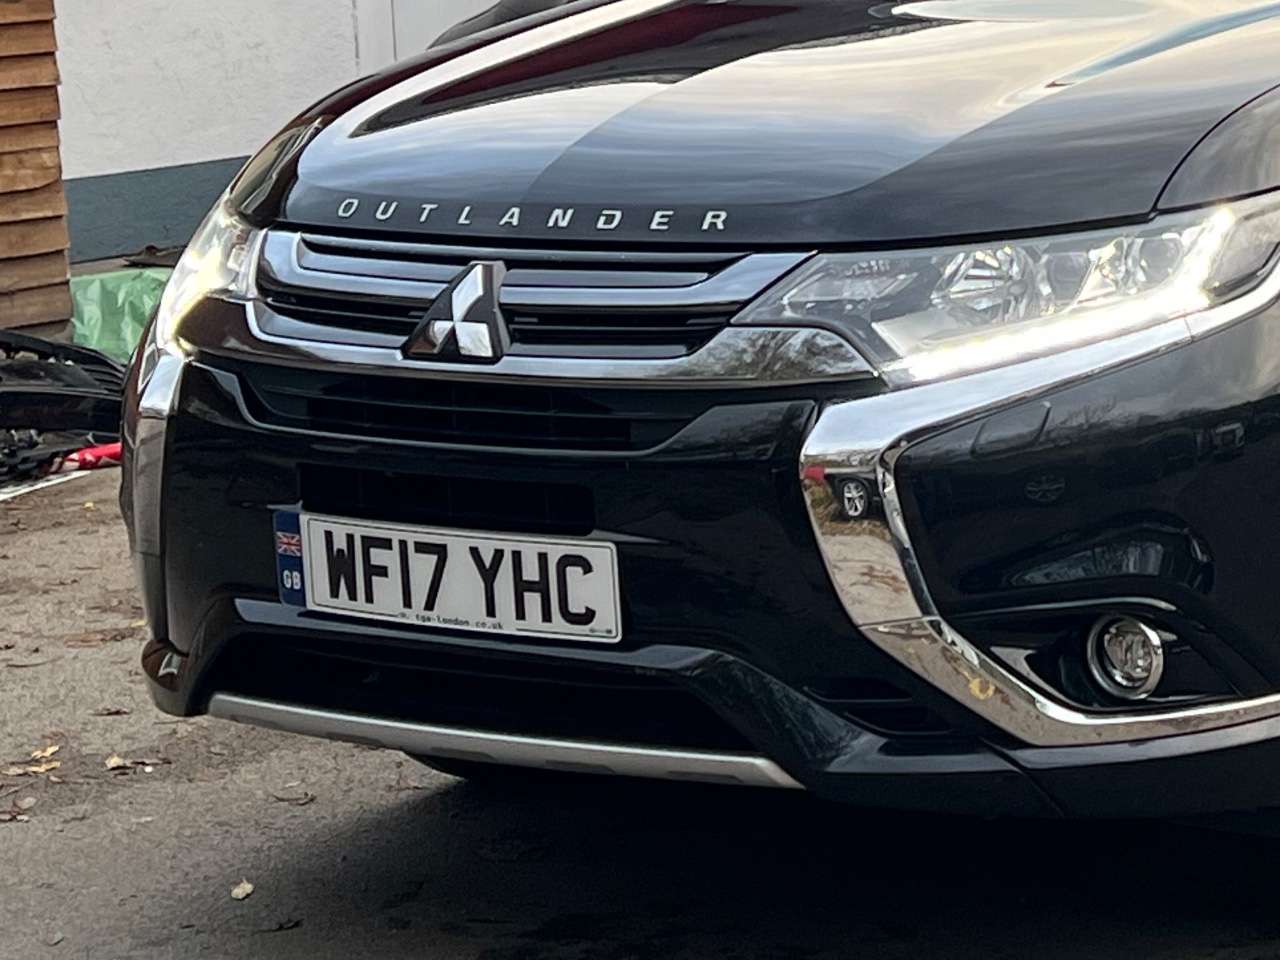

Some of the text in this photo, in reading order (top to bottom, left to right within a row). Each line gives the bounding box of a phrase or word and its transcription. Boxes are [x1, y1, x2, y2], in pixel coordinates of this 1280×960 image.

[337, 198, 728, 230] OUTLANDER
[282, 568, 302, 591] GB
[323, 529, 597, 626] WF17 YHC
